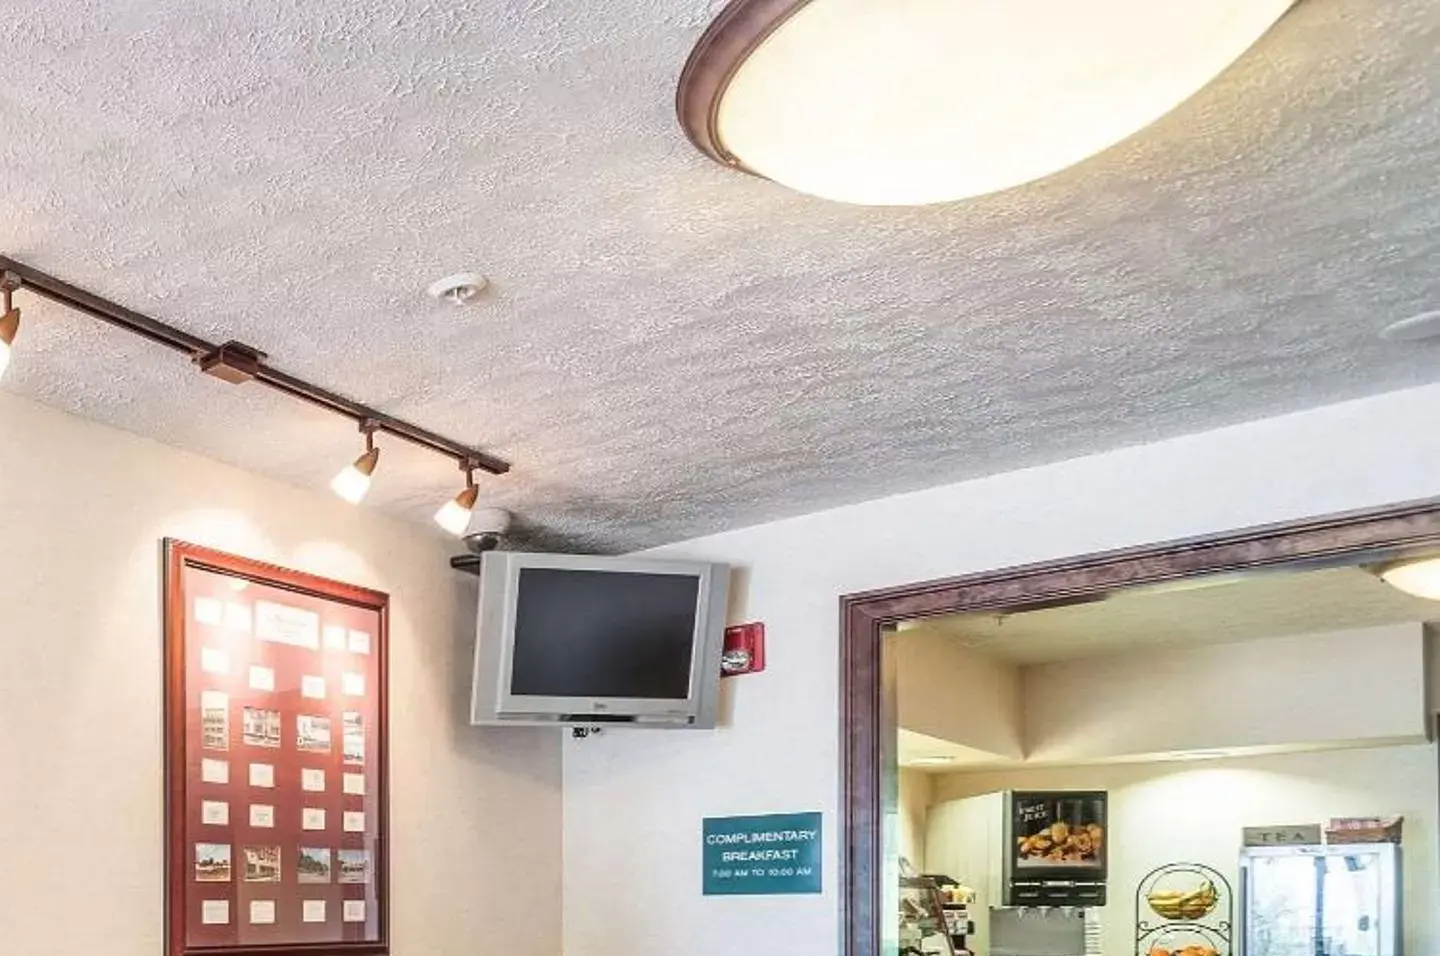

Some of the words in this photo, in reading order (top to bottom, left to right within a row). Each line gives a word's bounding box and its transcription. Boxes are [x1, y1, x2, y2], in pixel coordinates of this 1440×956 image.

[706, 830, 818, 845] COMPLIMENTARY
[1261, 832, 1305, 842] TEA
[722, 849, 799, 862] BREAKFAST
[734, 869, 749, 877] AM
[752, 868, 765, 877] TO
[796, 866, 813, 876] AM
